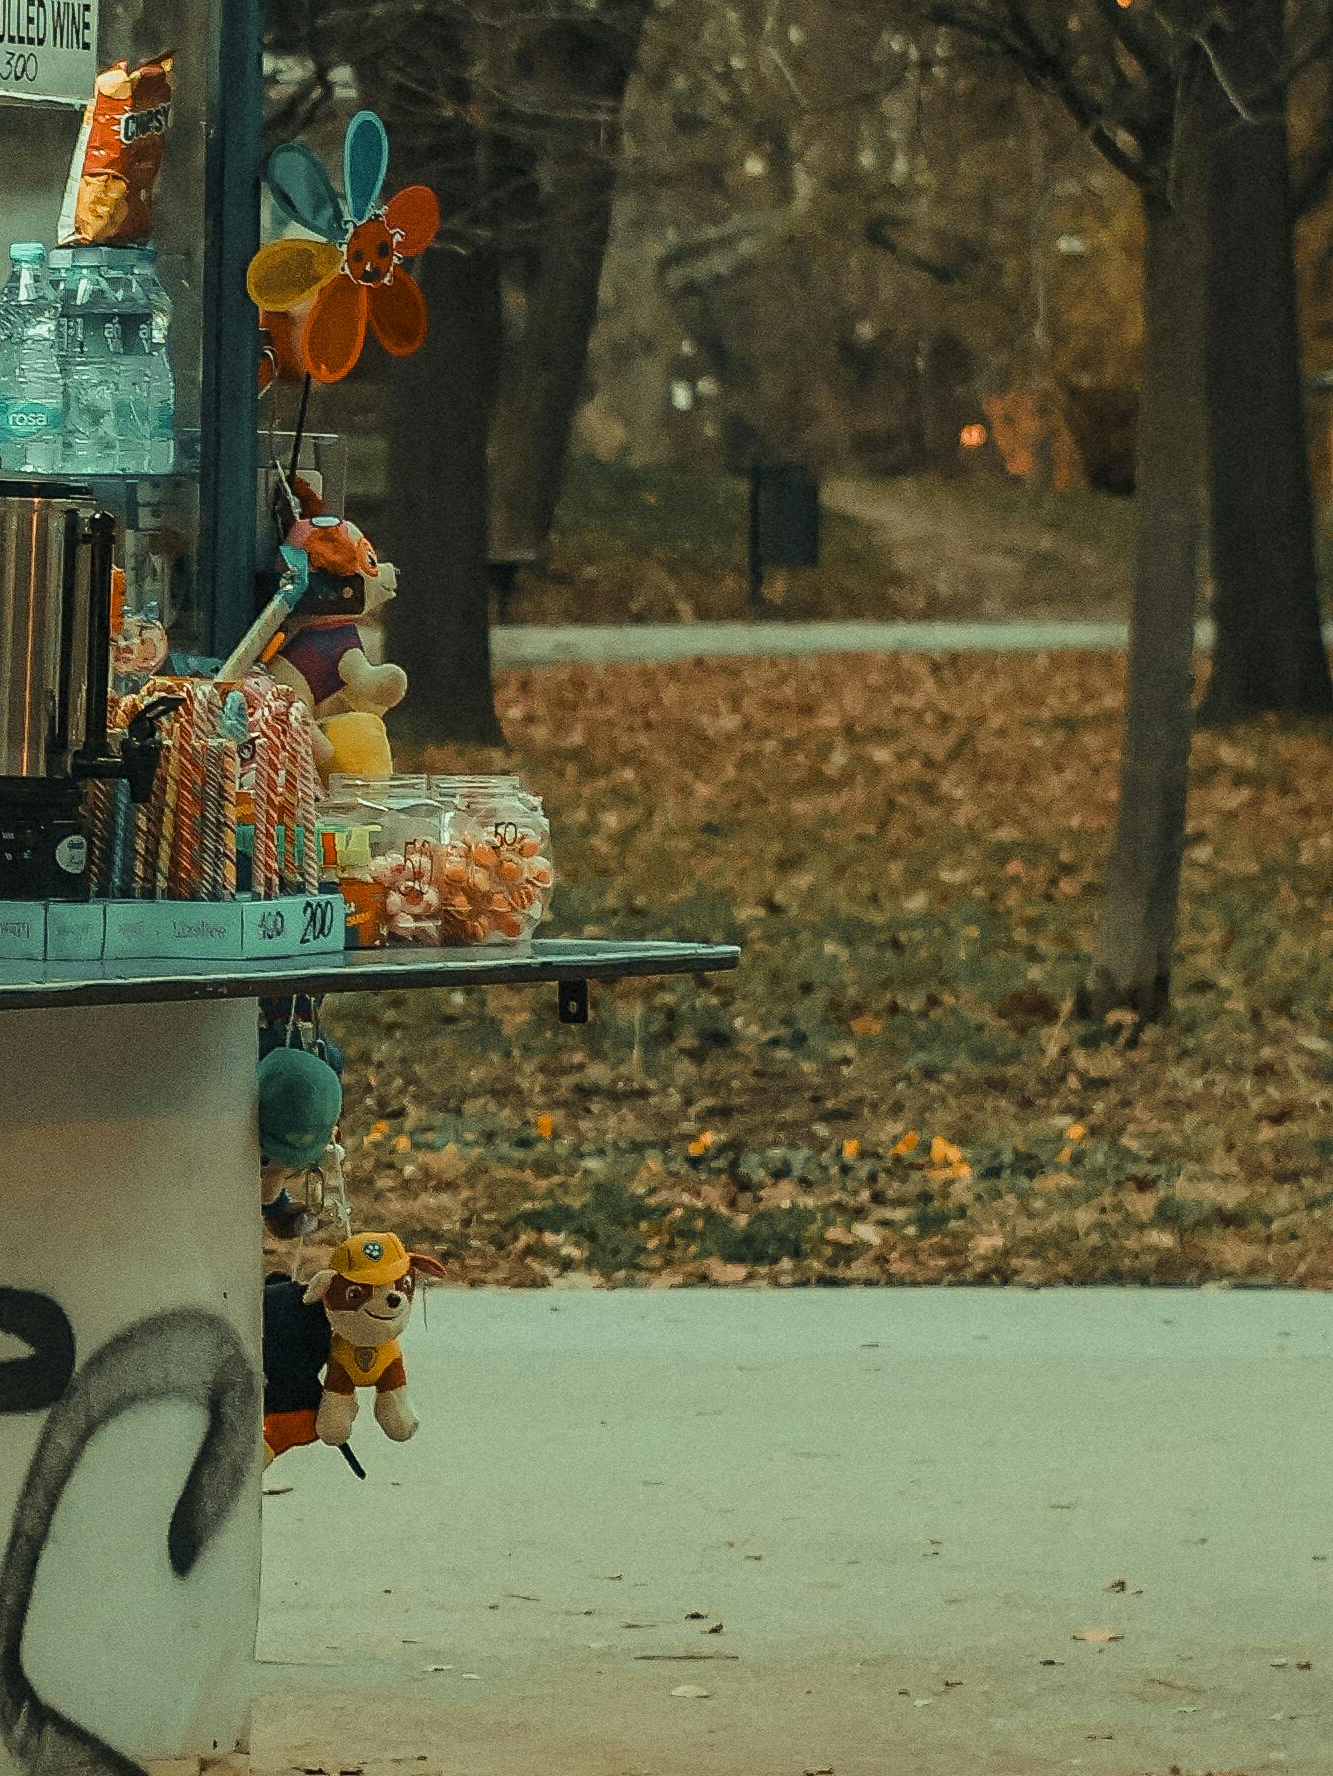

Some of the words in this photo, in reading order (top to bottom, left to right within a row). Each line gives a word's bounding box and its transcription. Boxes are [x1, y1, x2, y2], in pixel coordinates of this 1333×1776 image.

[51, 0, 91, 51] WINE
[0, 51, 39, 83] 300
[9, 412, 48, 426] rosa
[494, 822, 518, 849] 50
[299, 899, 335, 944] 200
